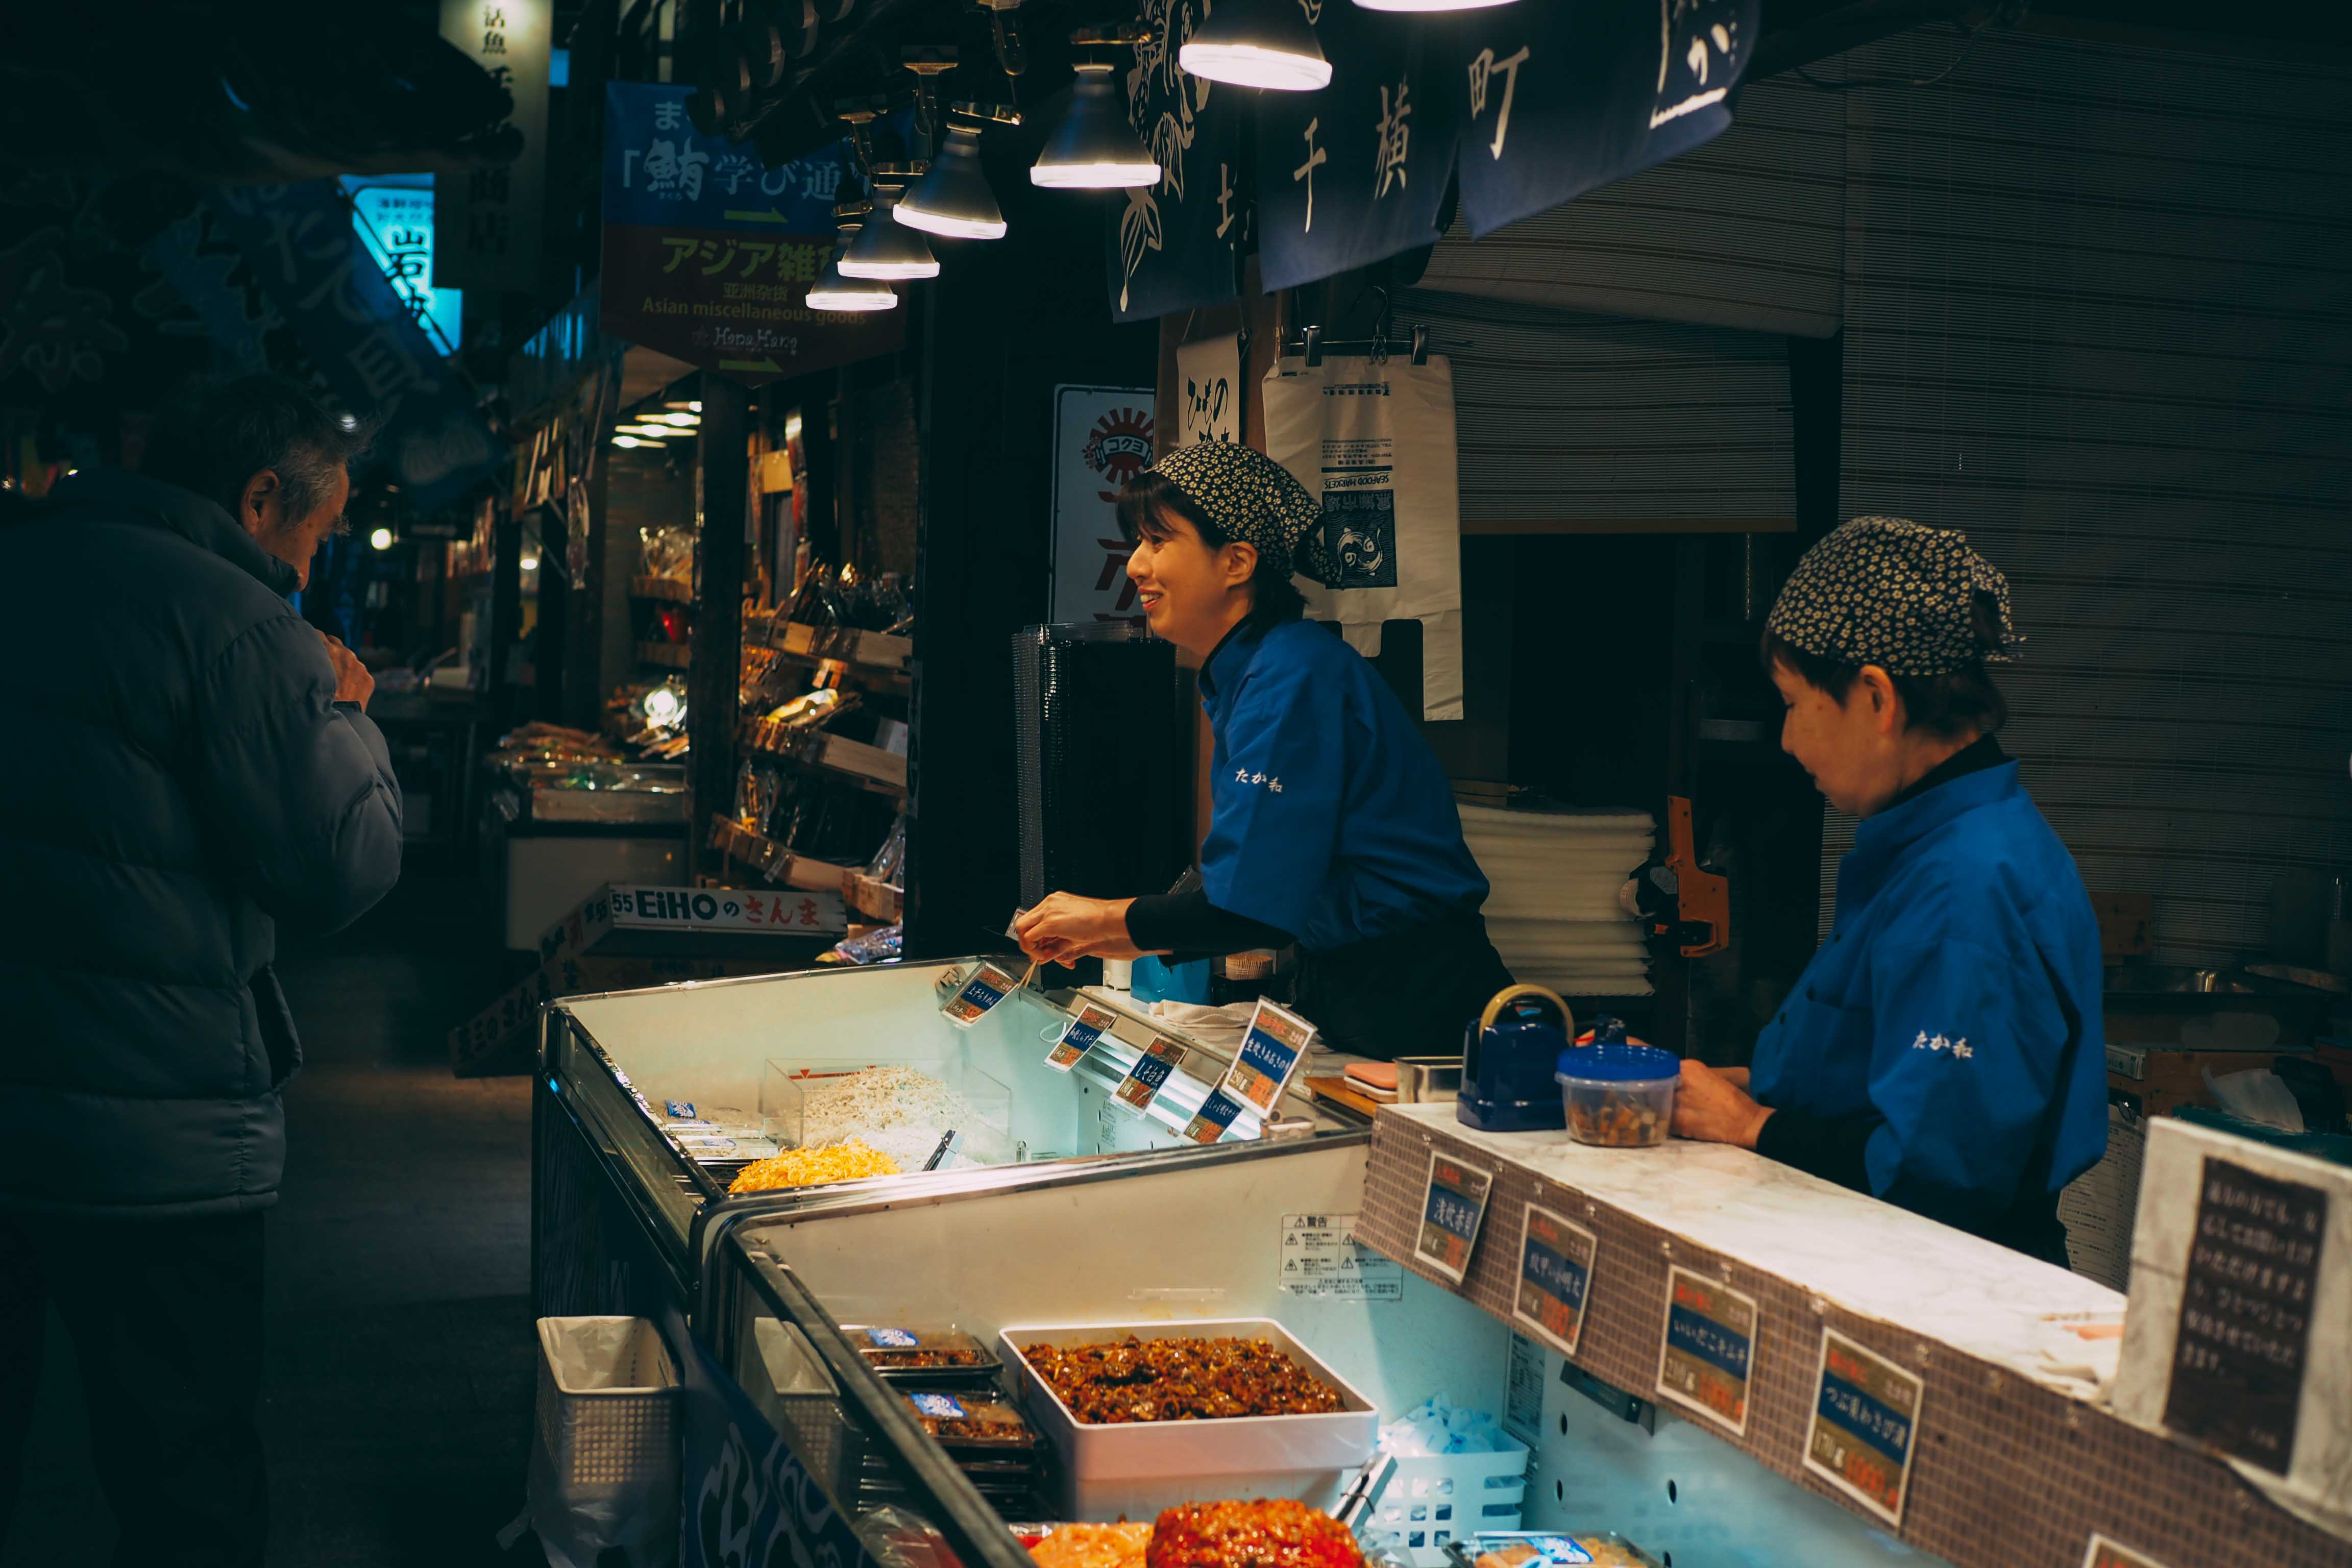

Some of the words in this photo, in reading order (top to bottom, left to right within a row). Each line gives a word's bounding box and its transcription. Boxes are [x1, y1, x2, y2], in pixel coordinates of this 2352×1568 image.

[642, 297, 688, 315] Asian
[693, 301, 811, 322] miscellaneous
[816, 310, 866, 327] goods
[1107, 438, 1145, 452] コクヨ
[1325, 479, 1356, 489] MARKETS
[1358, 475, 1389, 485] SEAFOOD
[612, 893, 633, 913] 55
[635, 890, 718, 920] EiHO
[723, 895, 820, 927] のさんま
[1307, 1216, 1328, 1228] 警告
